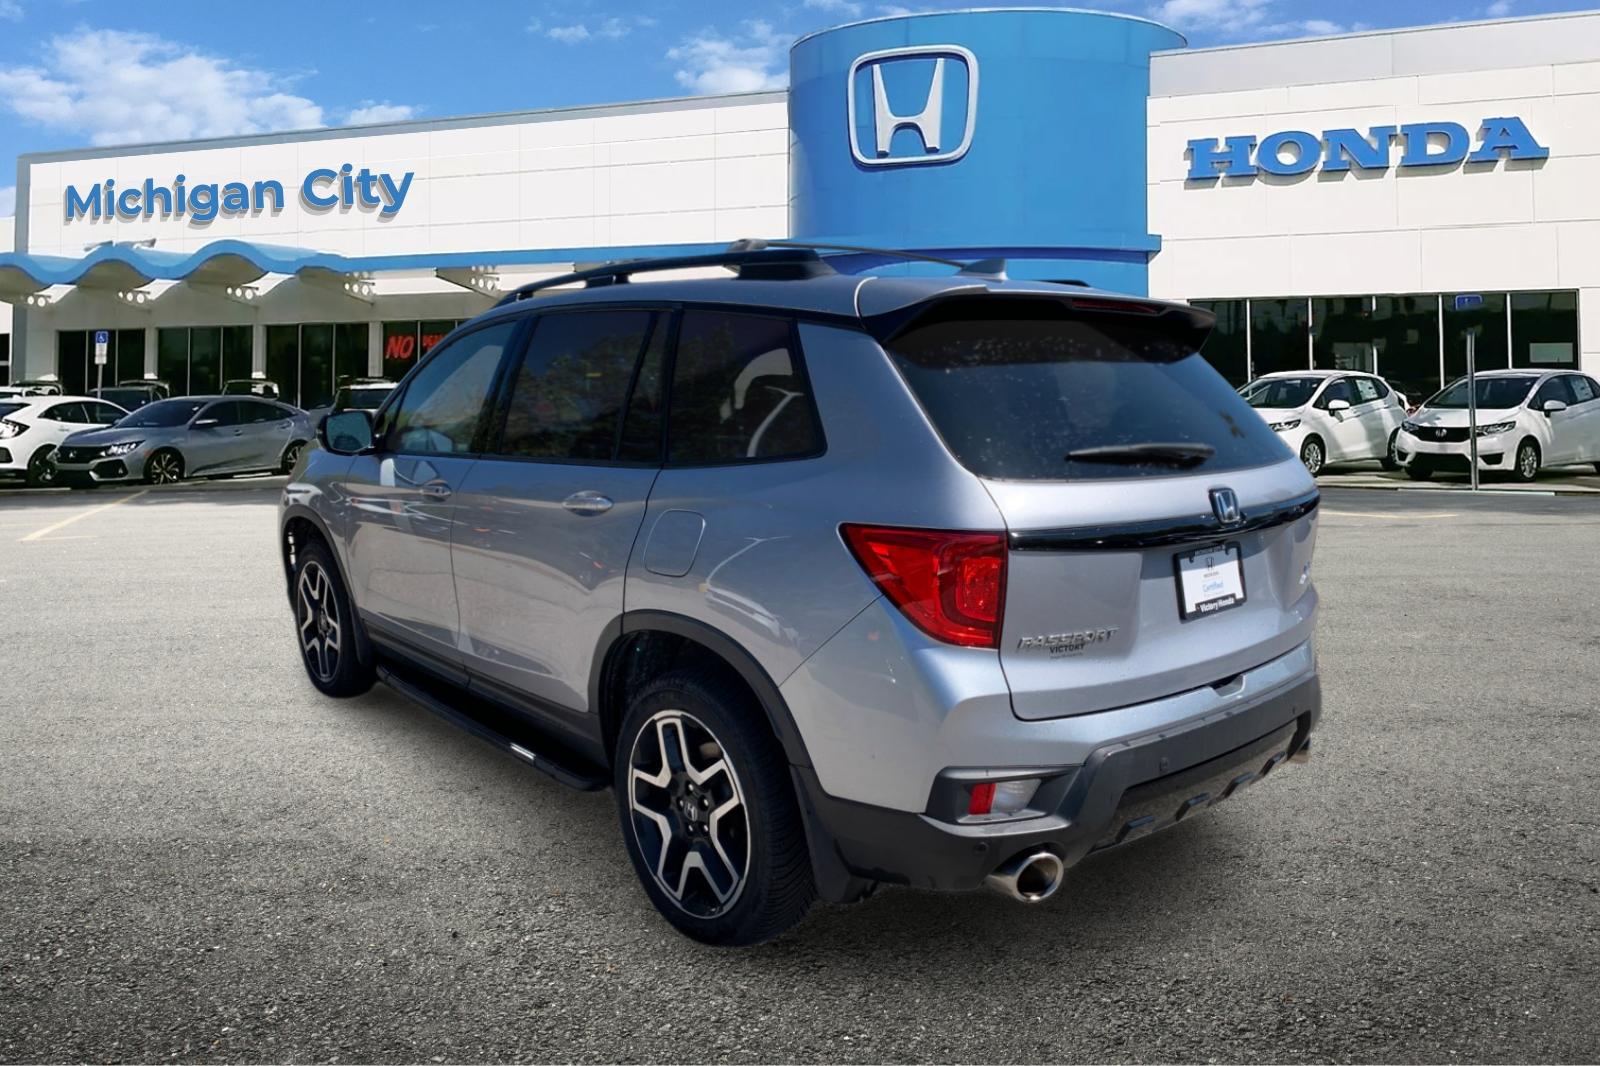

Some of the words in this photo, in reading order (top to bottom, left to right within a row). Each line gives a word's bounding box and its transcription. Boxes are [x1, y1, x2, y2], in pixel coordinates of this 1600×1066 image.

[1185, 116, 1550, 184] HONDA
[66, 174, 284, 222] Michigan
[303, 163, 415, 214] City
[385, 335, 415, 359] NO
[1049, 643, 1085, 653] VICTORY
